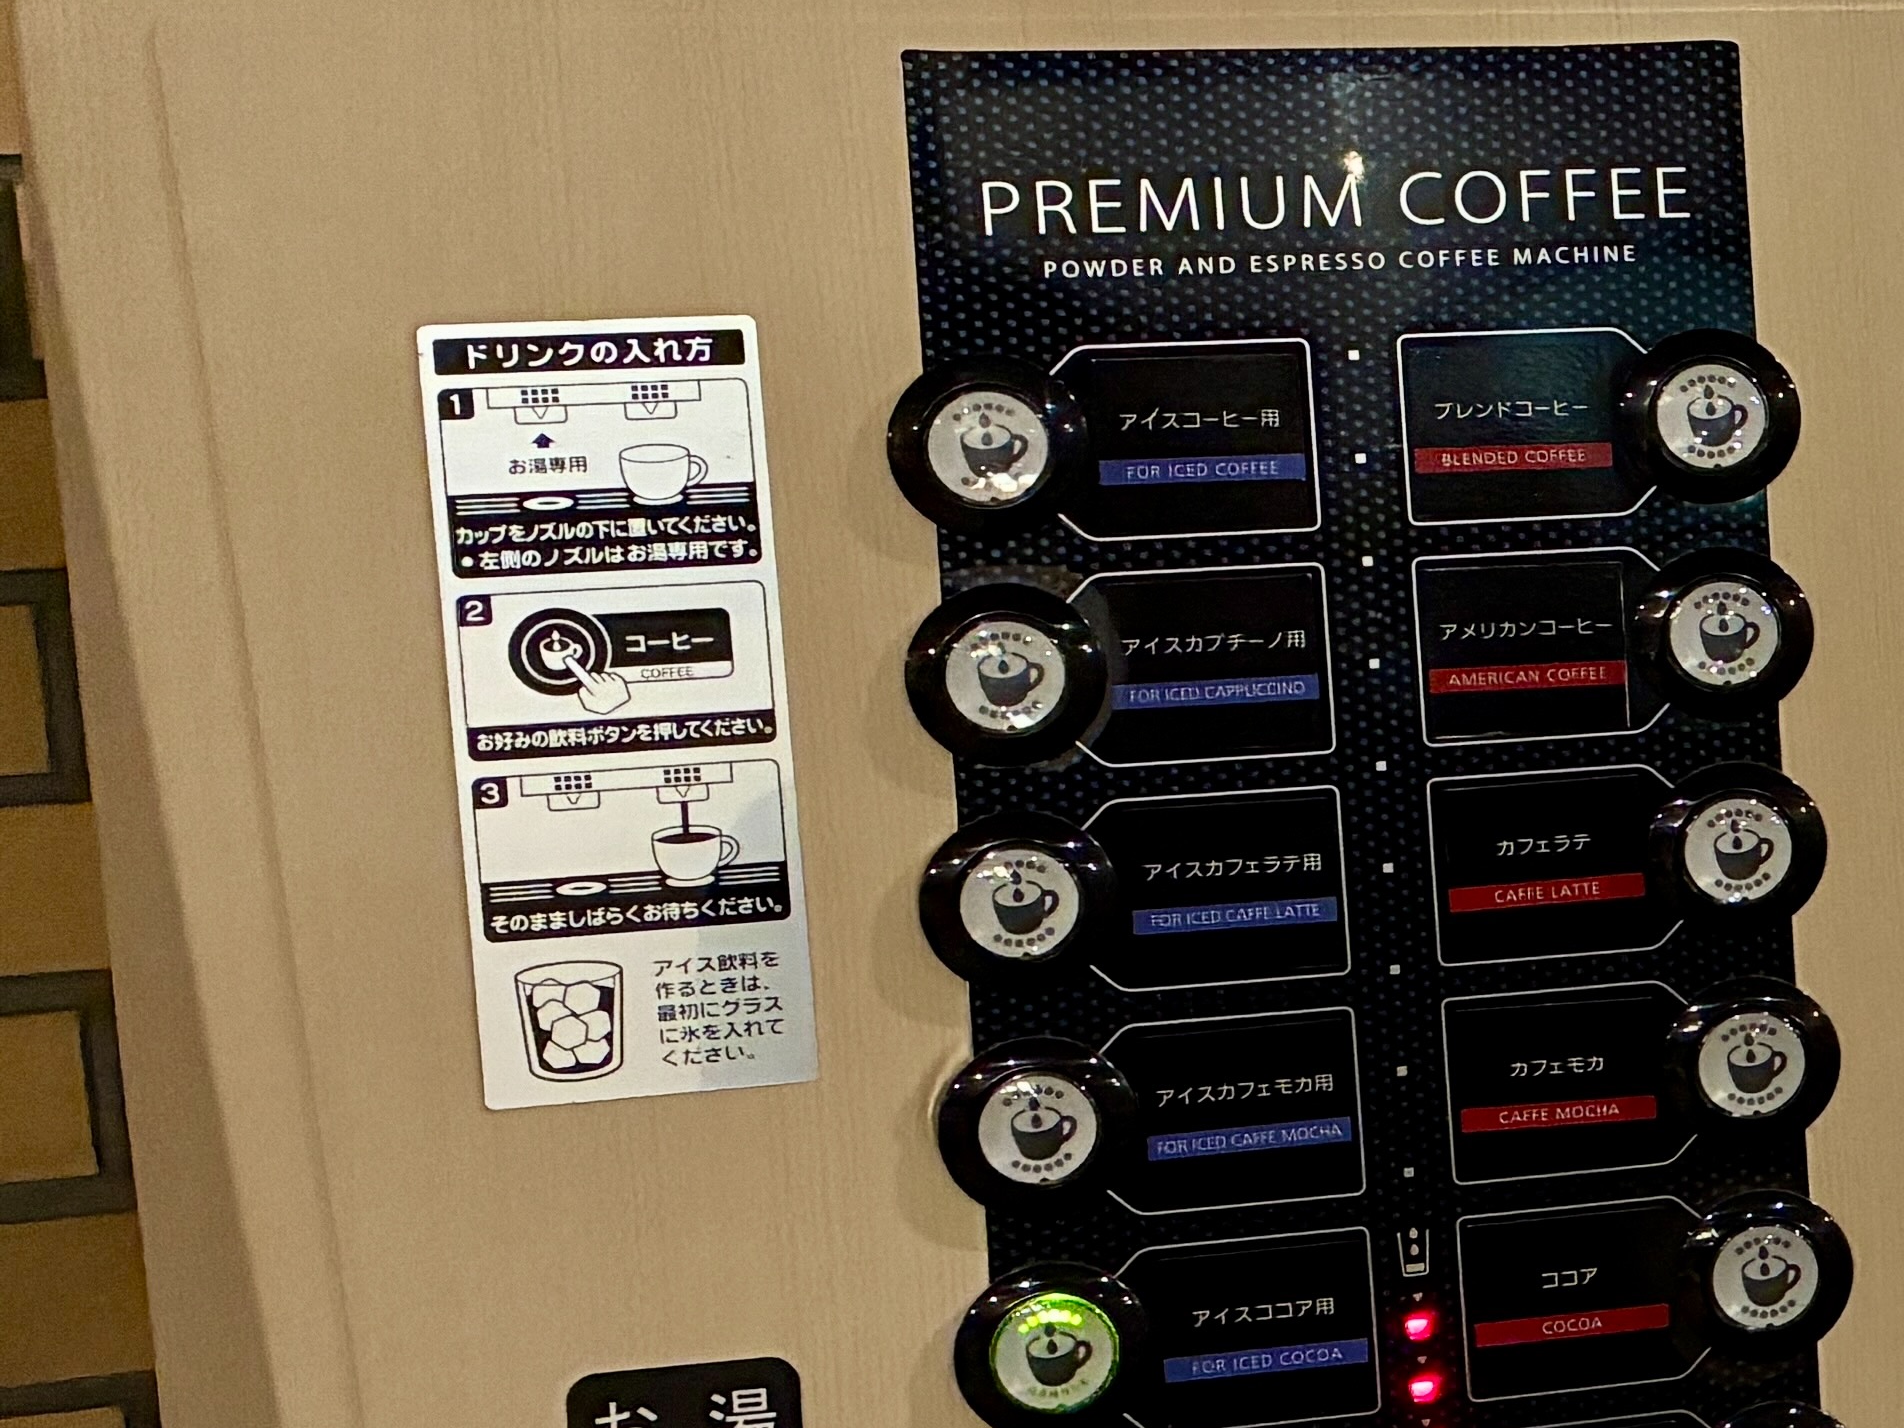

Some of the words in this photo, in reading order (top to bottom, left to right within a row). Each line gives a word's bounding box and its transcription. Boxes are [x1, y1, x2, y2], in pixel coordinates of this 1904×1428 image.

[981, 172, 1363, 237] PREMIUM
[1399, 166, 1692, 226] COFFEE
[1043, 257, 1164, 279] POWDER
[1177, 255, 1237, 276] AND
[1249, 250, 1387, 274] ESPRESSO
[1398, 247, 1501, 270] COFFEE
[1513, 243, 1637, 268] MACHINE
[466, 337, 713, 370] ドリンクの入れ方
[449, 393, 461, 416] 1
[1118, 406, 1281, 432] アイスコーヒー用
[508, 455, 589, 476] お湯専用
[1126, 465, 1161, 480] FOR
[1168, 462, 1208, 478] ICED
[1214, 459, 1280, 477] COFFEE
[1440, 450, 1519, 467] BLENDED
[1524, 448, 1587, 464] COFFEE
[464, 599, 485, 622] 2
[1439, 617, 1614, 642] アメリカンコーヒー
[624, 631, 715, 654] コーヒー
[1121, 629, 1307, 657] アイスカプチーノ用
[640, 664, 695, 681] COFFEE
[1448, 669, 1541, 687] AMERICAN
[1546, 666, 1608, 683] COFFEE
[476, 716, 774, 753] お好みの飲料ボタンを押してください。
[479, 782, 501, 805] 3
[1495, 833, 1592, 857] カフェラテ
[1141, 852, 1322, 882] アイスカフェラテ用
[1551, 880, 1601, 900] LATTE
[489, 895, 784, 935] そのまましばらくお待ちください。
[1186, 910, 1222, 926] ICED
[653, 951, 781, 977] アイス飲料を
[657, 996, 784, 1023] 最初にグラス
[659, 1018, 786, 1045] に氷を入れて
[661, 1044, 757, 1068] ください。
[1509, 1055, 1605, 1078] カフェモカ
[1155, 1073, 1335, 1109] アイスカフェモカ用
[1555, 1102, 1621, 1121] MOCHA
[1541, 1266, 1599, 1290] ココア
[1191, 1296, 1335, 1328] アイスココア用
[1541, 1316, 1603, 1335] COCOA
[1191, 1358, 1226, 1376] FOR
[1233, 1353, 1273, 1371] ICED
[1279, 1347, 1344, 1367] COCOA
